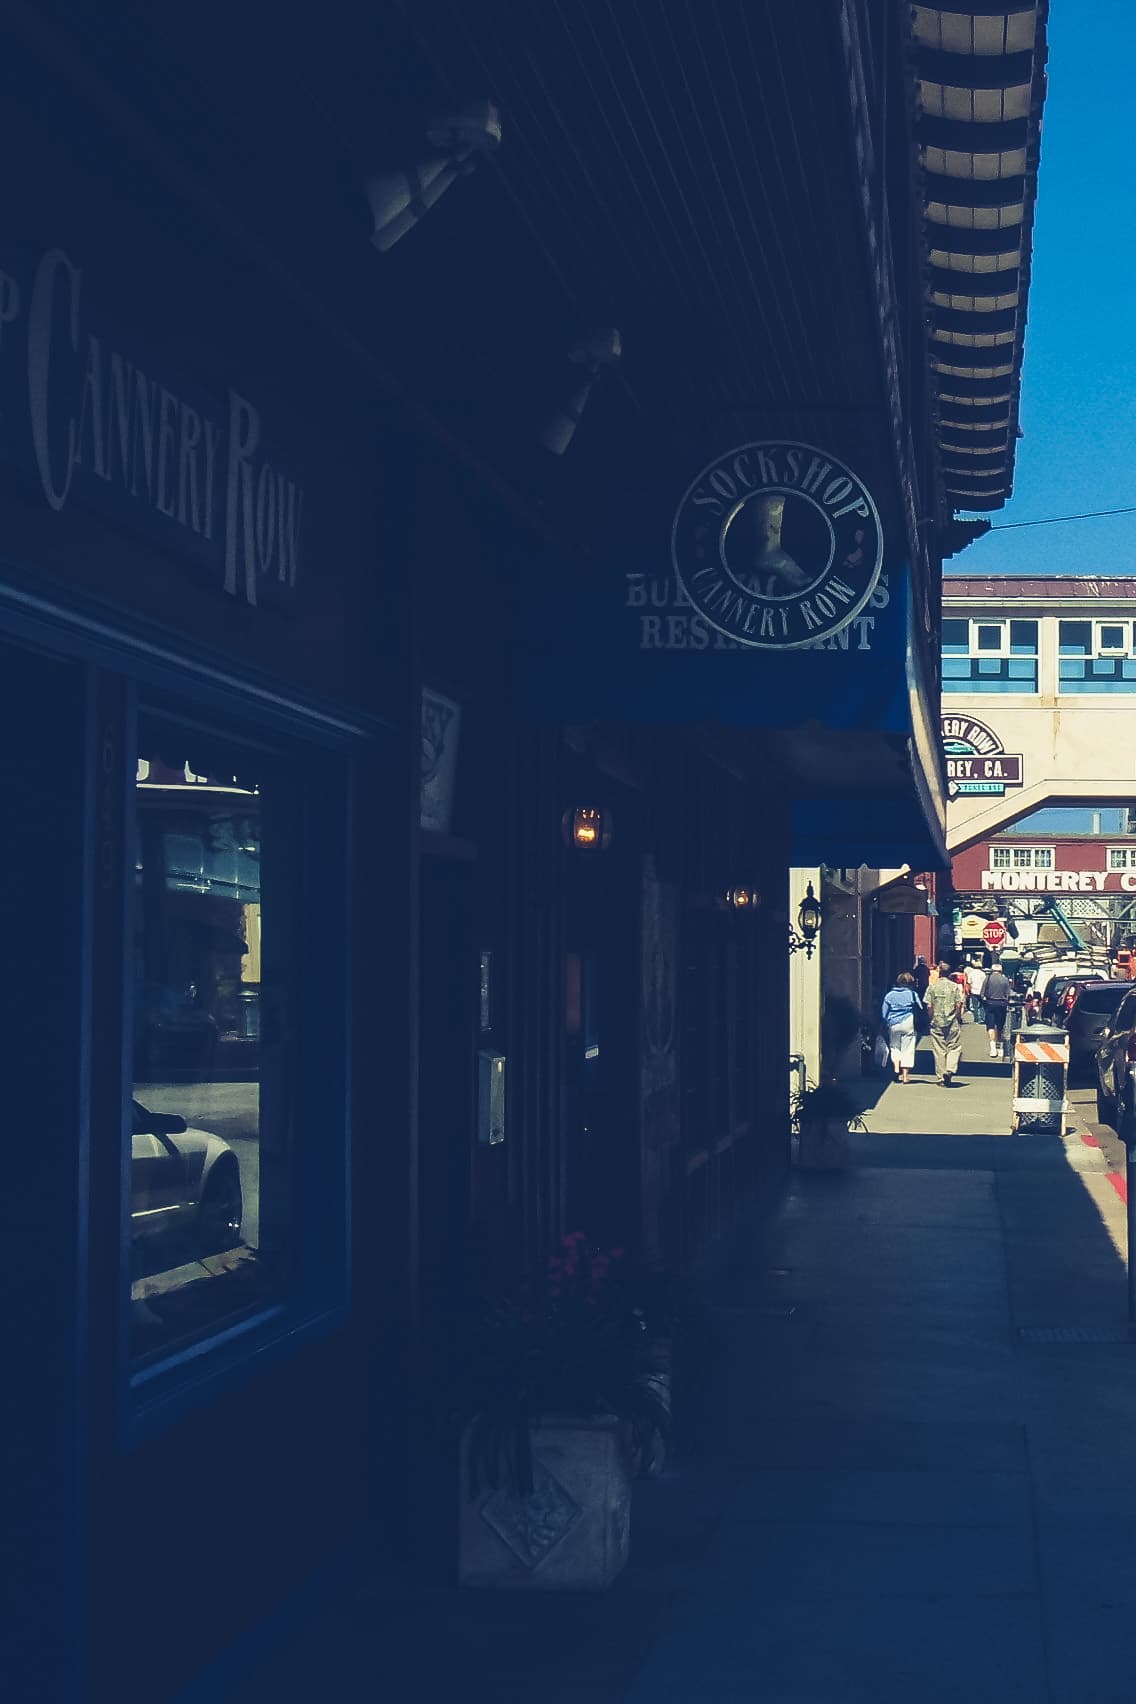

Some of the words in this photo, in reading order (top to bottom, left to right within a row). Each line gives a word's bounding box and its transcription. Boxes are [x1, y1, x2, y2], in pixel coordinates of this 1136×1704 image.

[27, 247, 222, 542] CANNERY
[223, 385, 304, 607] ROW
[691, 448, 870, 519] SOCKSHOP
[800, 575, 857, 631] ROW
[966, 725, 997, 755] ROW
[984, 760, 1008, 778] CA.
[981, 870, 1109, 891] MONTEREY
[983, 928, 1006, 938] STOP
